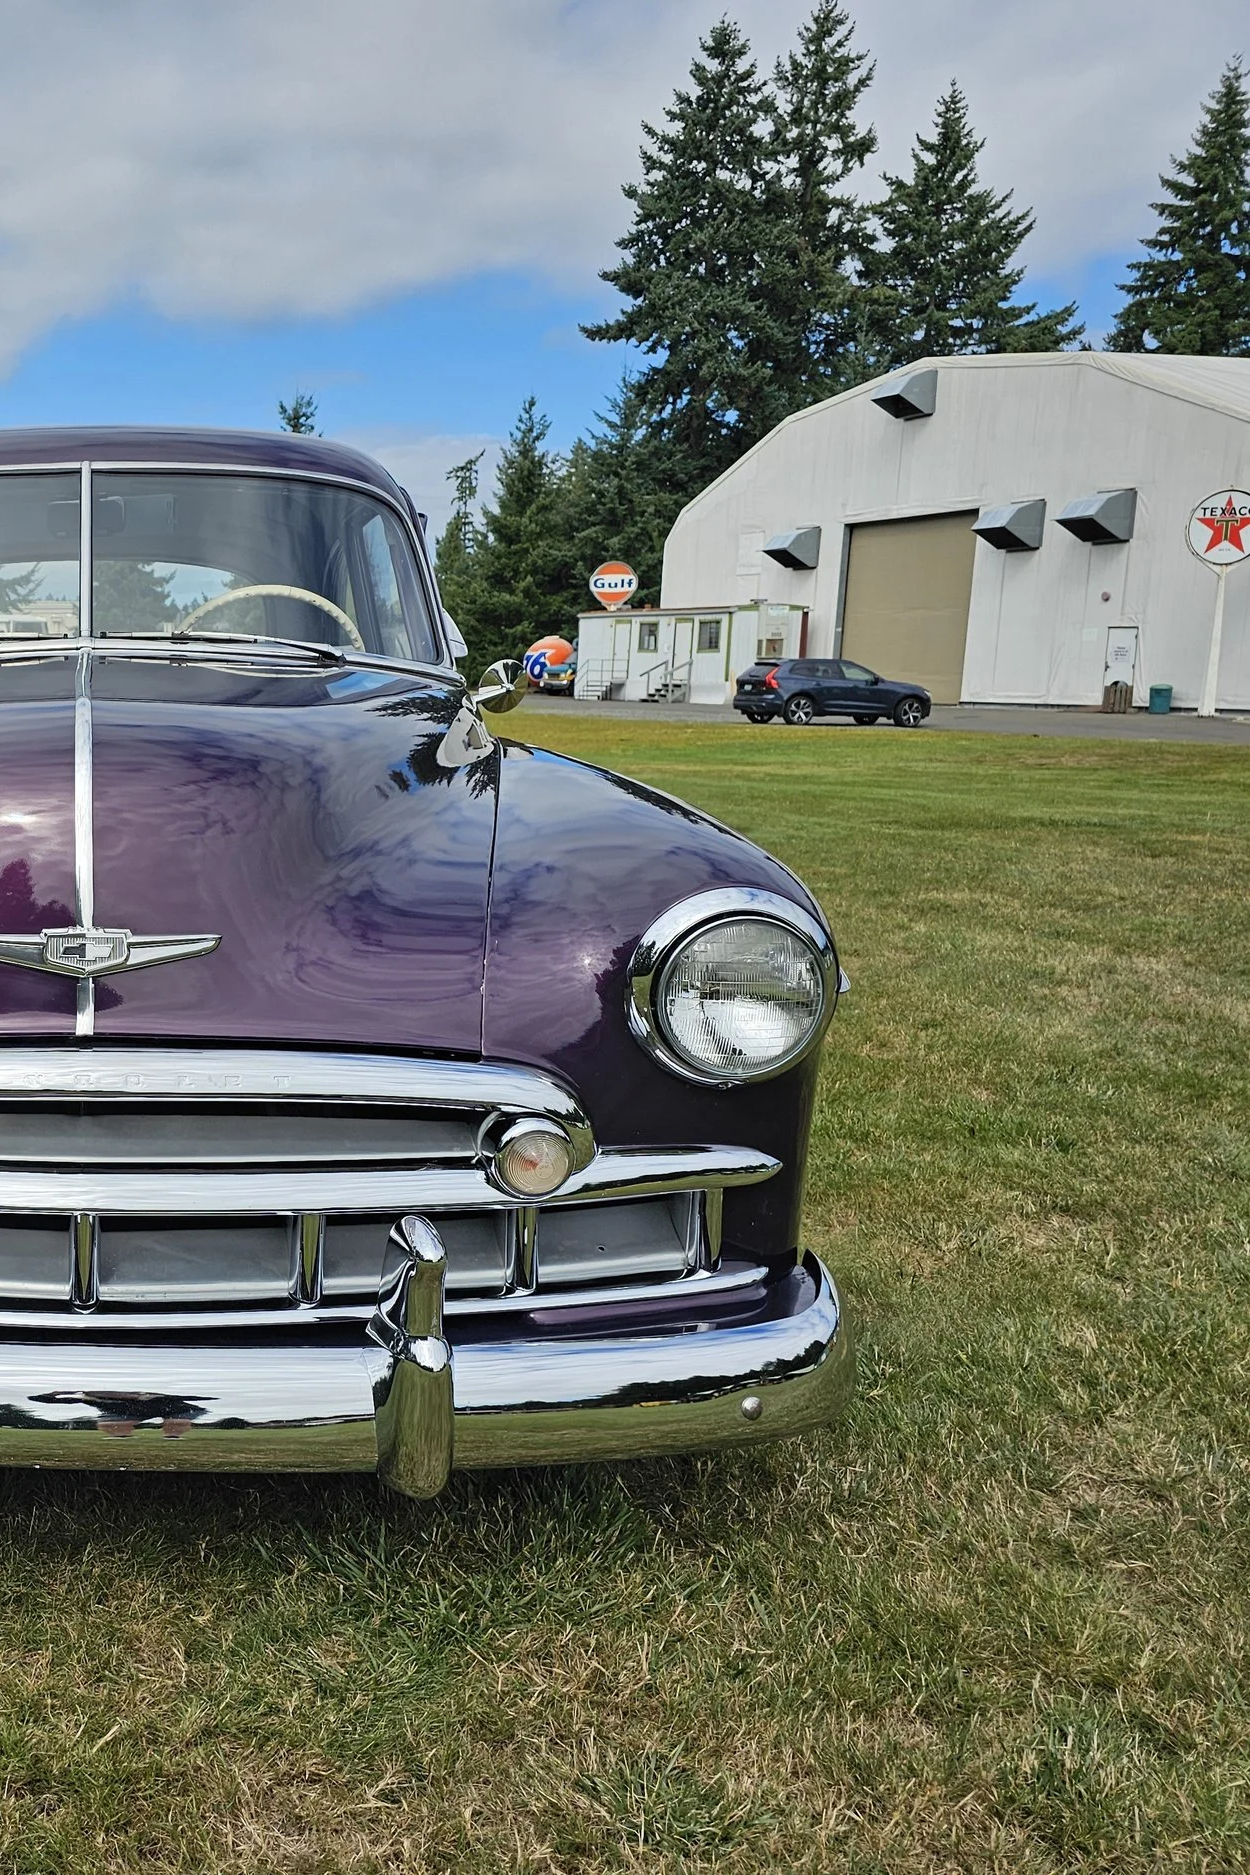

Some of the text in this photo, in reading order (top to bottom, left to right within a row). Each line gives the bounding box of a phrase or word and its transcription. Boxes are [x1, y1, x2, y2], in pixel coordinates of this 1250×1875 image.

[1201, 506, 1250, 517] TEXAC
[593, 577, 634, 589] Gulf
[524, 651, 548, 680] 76
